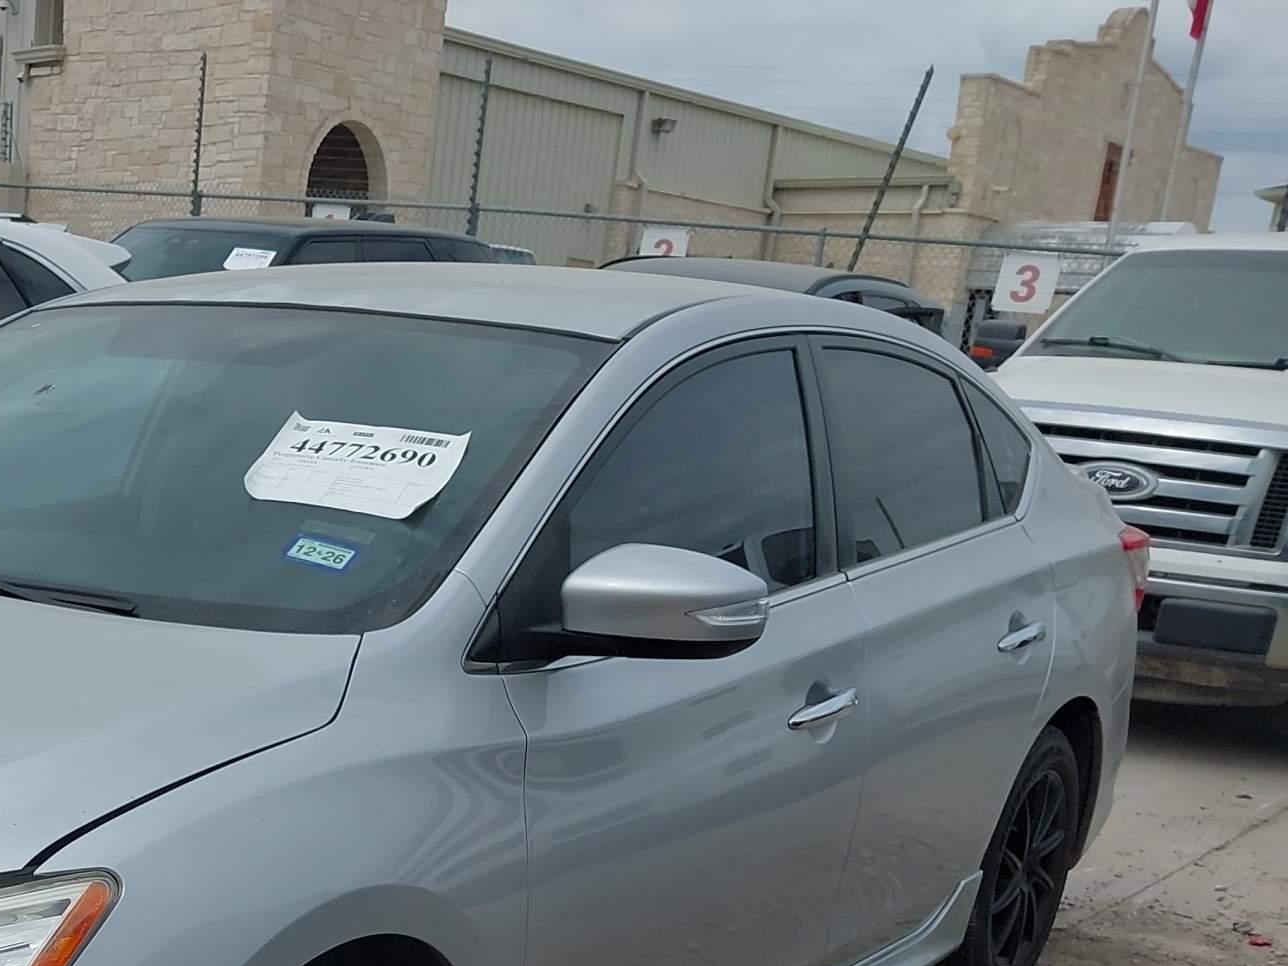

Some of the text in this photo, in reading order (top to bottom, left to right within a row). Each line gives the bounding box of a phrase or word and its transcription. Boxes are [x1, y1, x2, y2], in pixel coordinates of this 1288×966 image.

[1009, 264, 1041, 304] 3
[289, 438, 438, 469] 44772690
[1090, 470, 1132, 489] Ford
[295, 544, 347, 565] 12 26
